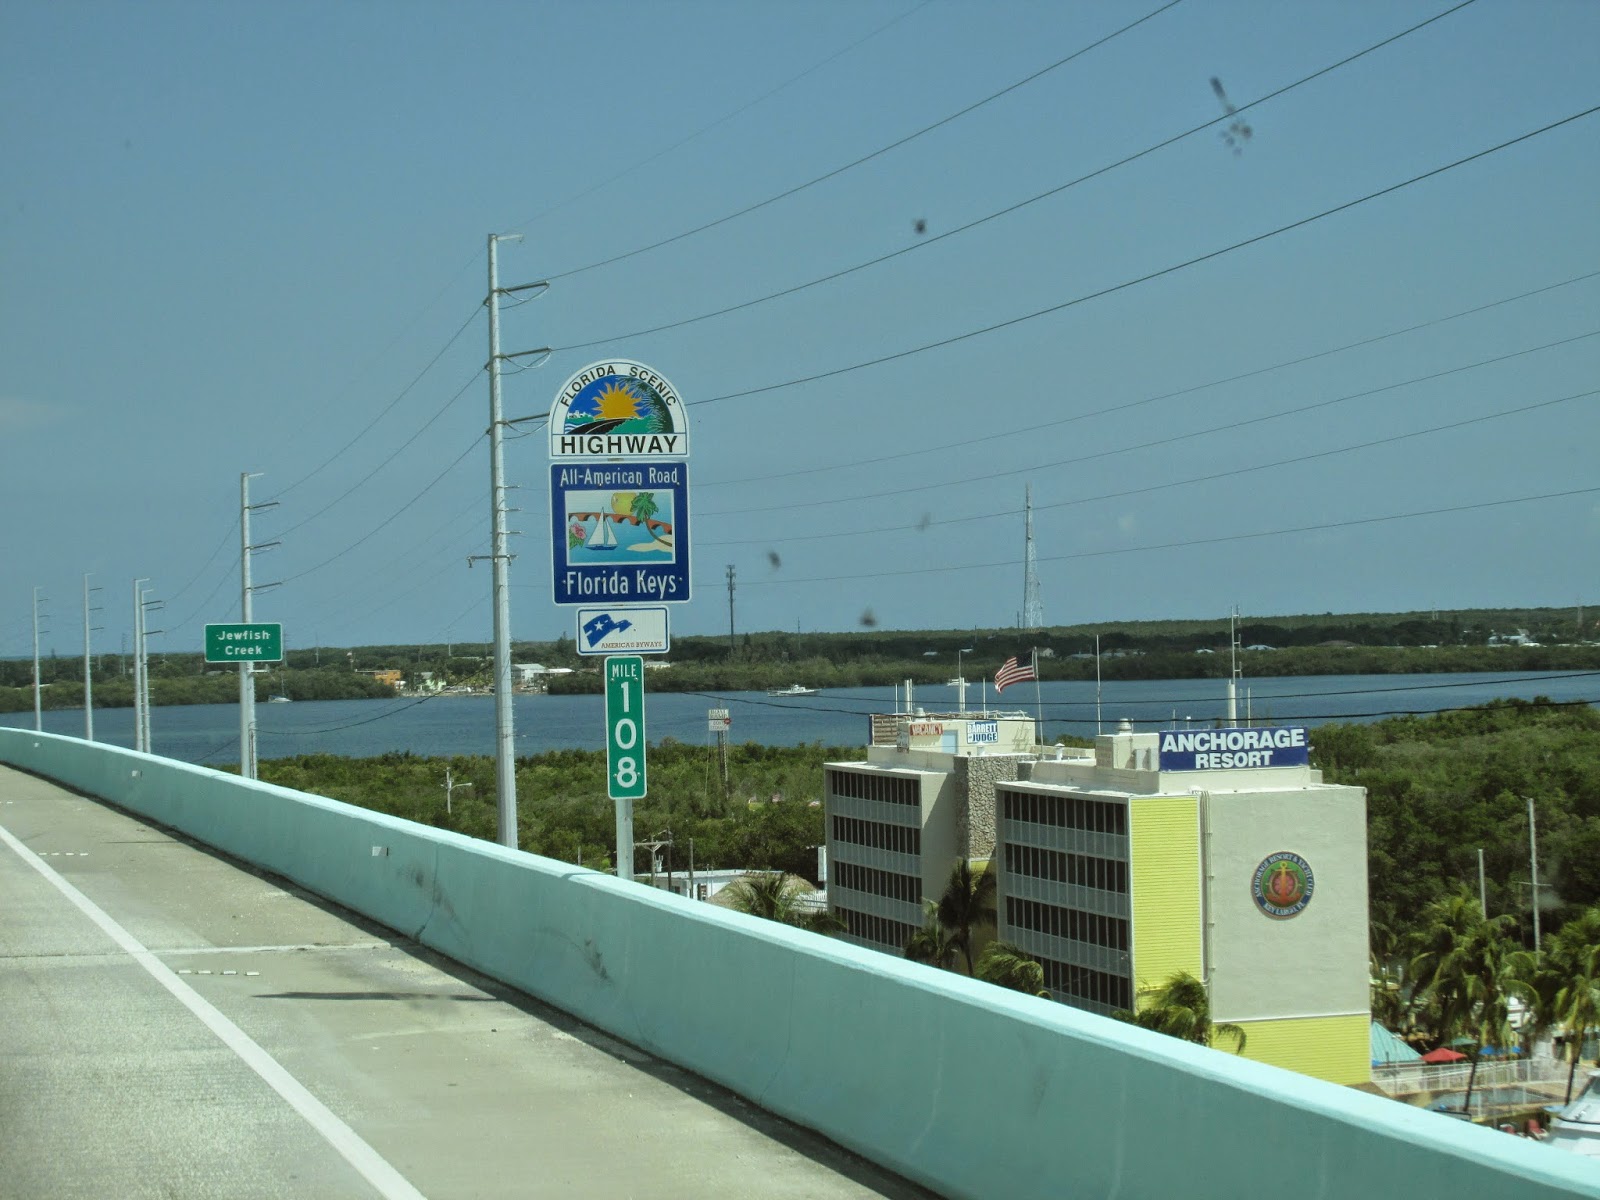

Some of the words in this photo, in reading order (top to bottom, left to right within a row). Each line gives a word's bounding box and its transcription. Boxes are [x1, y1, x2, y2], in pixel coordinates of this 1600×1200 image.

[560, 365, 616, 407] FLORIDA
[629, 366, 676, 406] SCENIC
[561, 435, 678, 454] HIGHWAY
[561, 467, 642, 485] All-American
[649, 467, 678, 484] Road
[566, 570, 629, 595] Florida
[636, 569, 676, 600] Keys
[218, 630, 269, 640] Jewfish
[225, 645, 262, 655] Creek
[612, 664, 637, 678] MILE
[911, 723, 943, 736] VACANCY
[967, 723, 997, 733] BARRETT
[972, 733, 997, 742] JUDGE
[1161, 729, 1305, 752] ANCHORAGE
[1195, 751, 1273, 769] RESORT
